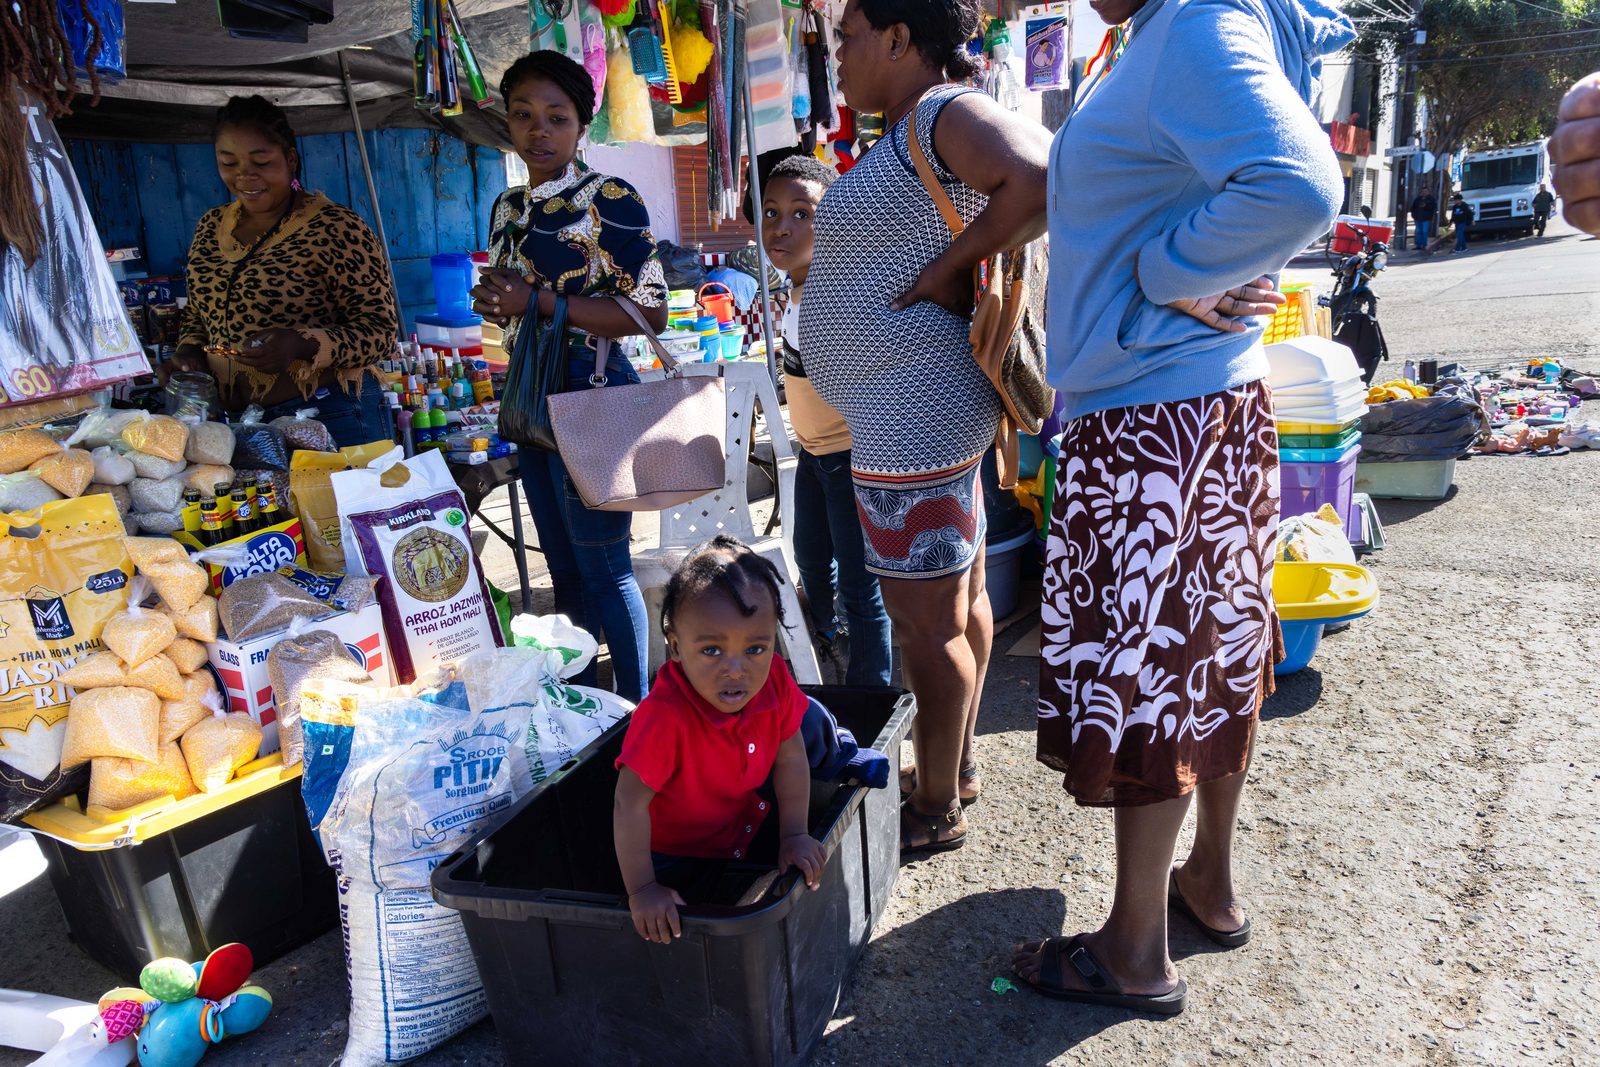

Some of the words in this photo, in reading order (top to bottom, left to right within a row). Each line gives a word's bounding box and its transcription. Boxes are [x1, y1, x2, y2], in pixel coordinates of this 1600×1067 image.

[388, 508, 431, 526] KIRKLAND
[405, 605, 447, 627] ARROZ
[450, 592, 482, 614] JAZMÍN
[36, 624, 70, 634] Member's
[414, 622, 438, 636] THAI
[440, 615, 462, 629] HOM
[463, 606, 481, 621] MALI
[436, 635, 454, 644] ARROZ
[455, 626, 475, 638] BLANCO
[446, 637, 464, 647] GRANO
[464, 630, 480, 640] LARGO
[19, 650, 45, 662] THAI
[50, 647, 71, 658] HOM
[74, 638, 101, 653] MALI
[219, 649, 240, 667] GLASS
[440, 642, 471, 657] PERFUMADO
[441, 643, 481, 662] NATURALMENTE
[449, 746, 506, 764] SROOB
[445, 783, 488, 799] Sorghum
[431, 806, 486, 830] Premium
[387, 912, 425, 921] Calories
[395, 1012, 432, 1023] Imported
[441, 995, 478, 1013] Marketed
[419, 1016, 449, 1028] PRODUCT
[397, 1041, 426, 1050] Florida
